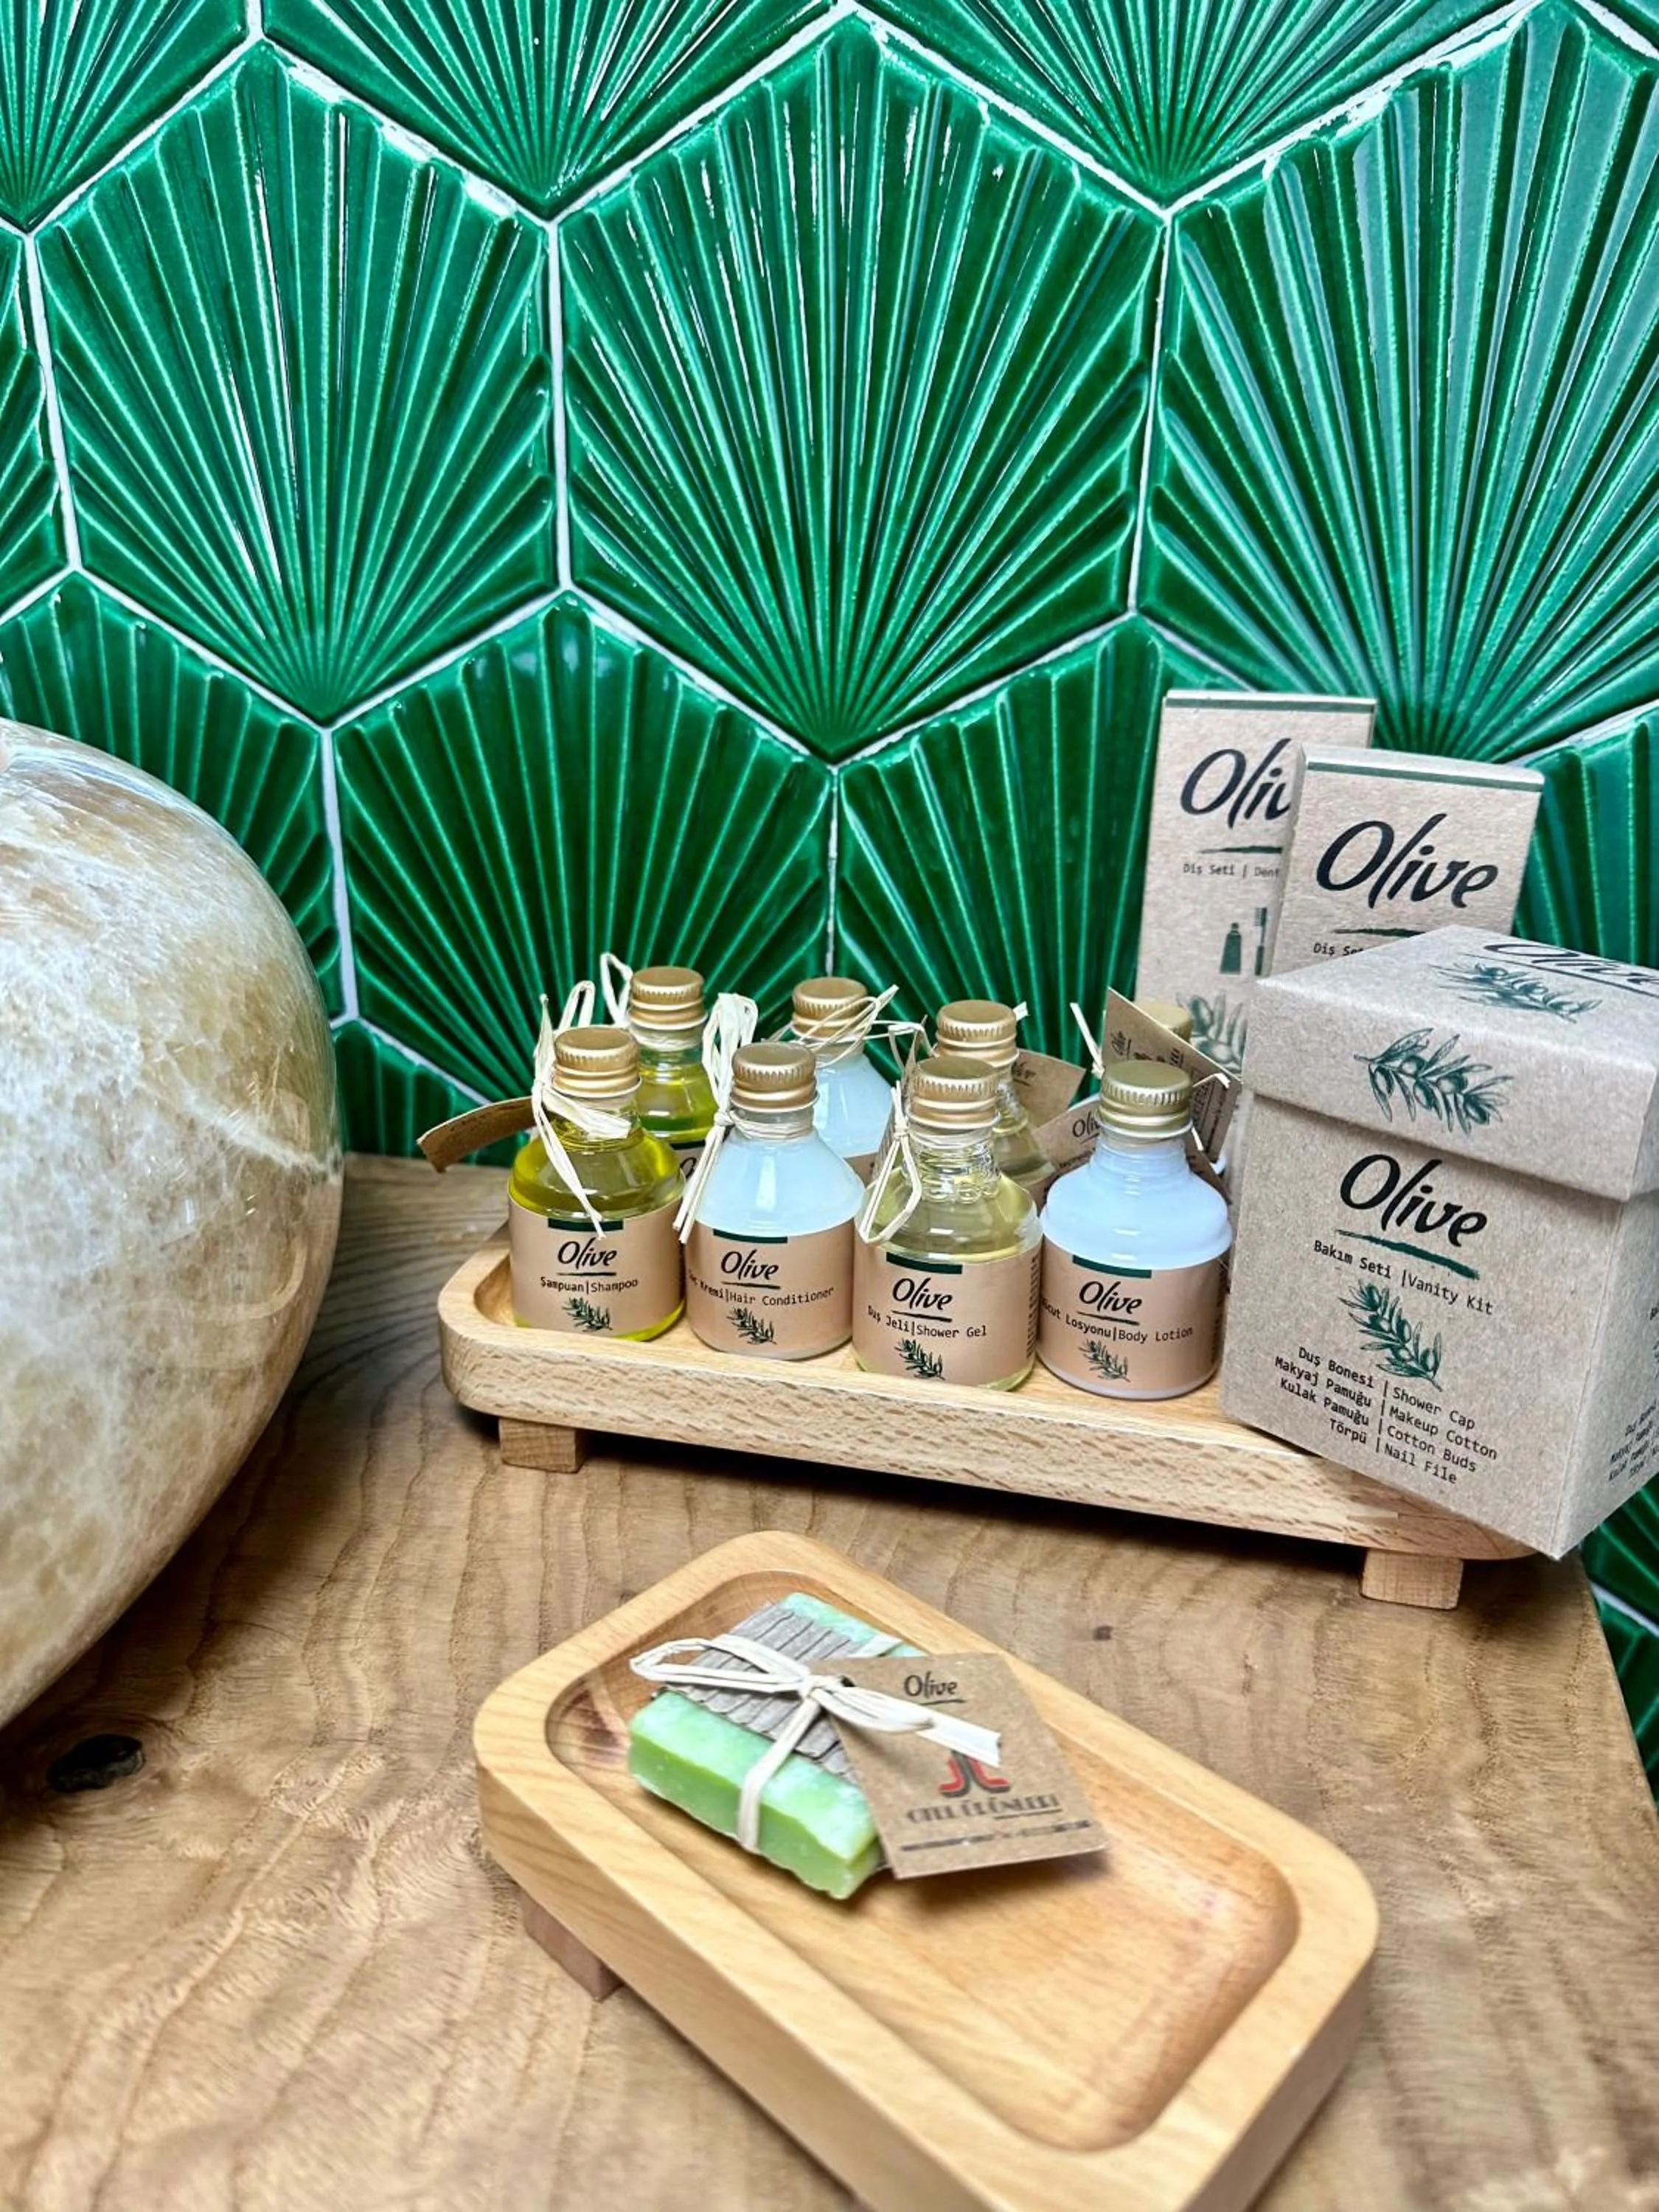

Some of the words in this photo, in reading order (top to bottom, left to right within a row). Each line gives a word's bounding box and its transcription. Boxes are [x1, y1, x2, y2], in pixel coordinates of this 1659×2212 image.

[1316, 813, 1498, 908] Olive
[1340, 1154, 1487, 1248] Olive
[557, 1237, 618, 1270] Olive
[720, 1249, 779, 1281] Olive
[892, 1277, 953, 1310] Olive
[1314, 1239, 1353, 1265] Bakım
[1359, 1257, 1392, 1279] Seti
[1467, 1295, 1494, 1315] Kit
[762, 1287, 835, 1306] Conditioner
[1079, 1281, 1143, 1315] Olive
[967, 1325, 987, 1338] Gel
[1155, 1326, 1193, 1342] Lotion
[1298, 1346, 1321, 1368] Duş
[1328, 1360, 1374, 1388] Bonesi
[1392, 1387, 1442, 1415] Shower
[1449, 1410, 1475, 1431] Cap
[1275, 1356, 1319, 1387] Makyaj
[1326, 1378, 1371, 1408] Pamuğu
[1389, 1405, 1439, 1436] Makeup
[1446, 1430, 1498, 1460] Cotton
[1280, 1377, 1317, 1403] Kulak
[1324, 1397, 1369, 1426] Pamuğu
[1387, 1425, 1436, 1455] Cotton
[1443, 1448, 1477, 1472] Buds
[1329, 1418, 1367, 1444] Törpü
[1384, 1442, 1416, 1467] Nail
[1424, 1461, 1458, 1484] File
[903, 1670, 958, 1699] Olive
